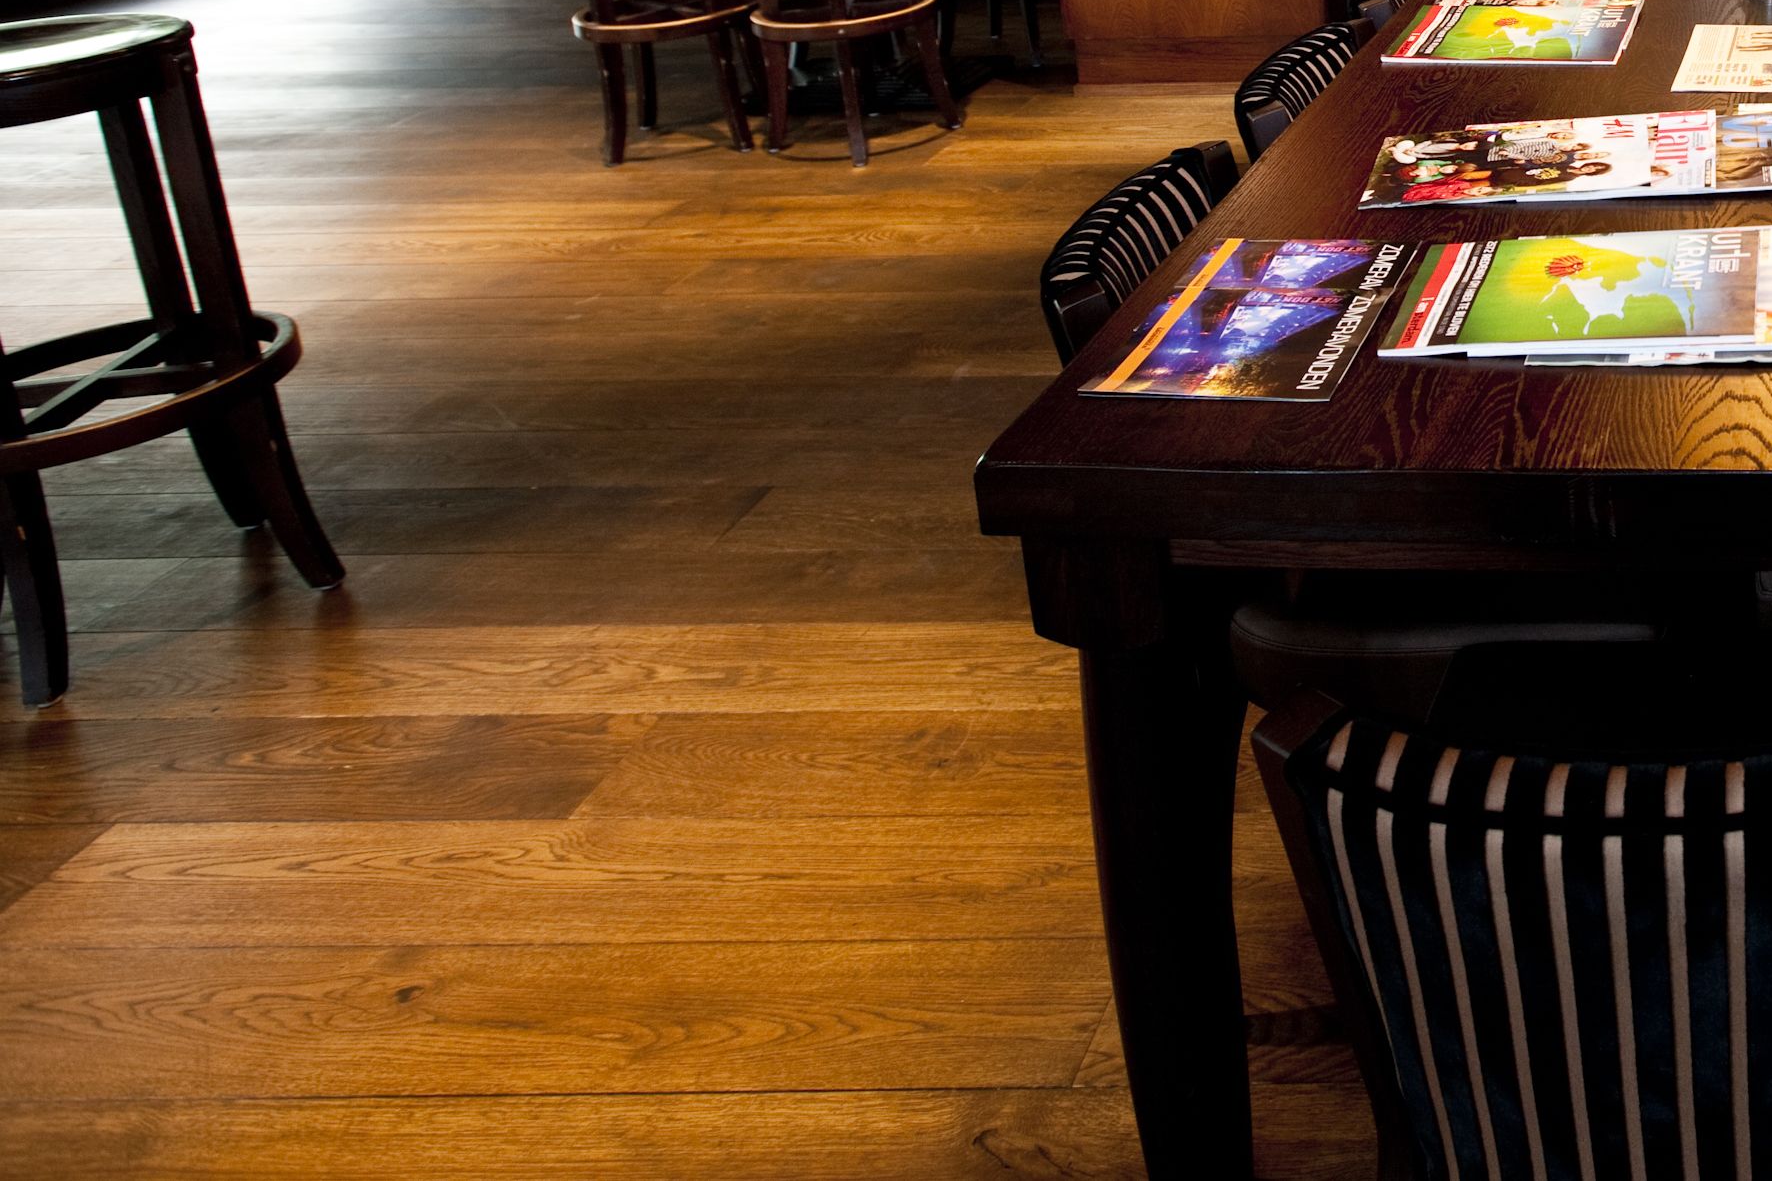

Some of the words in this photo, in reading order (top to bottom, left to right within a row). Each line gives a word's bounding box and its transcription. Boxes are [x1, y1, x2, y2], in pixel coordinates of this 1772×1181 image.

[1655, 110, 1710, 165] Flair
[1669, 233, 1709, 291] KRANT
[1295, 293, 1378, 390] ZOMERAVONDEN
